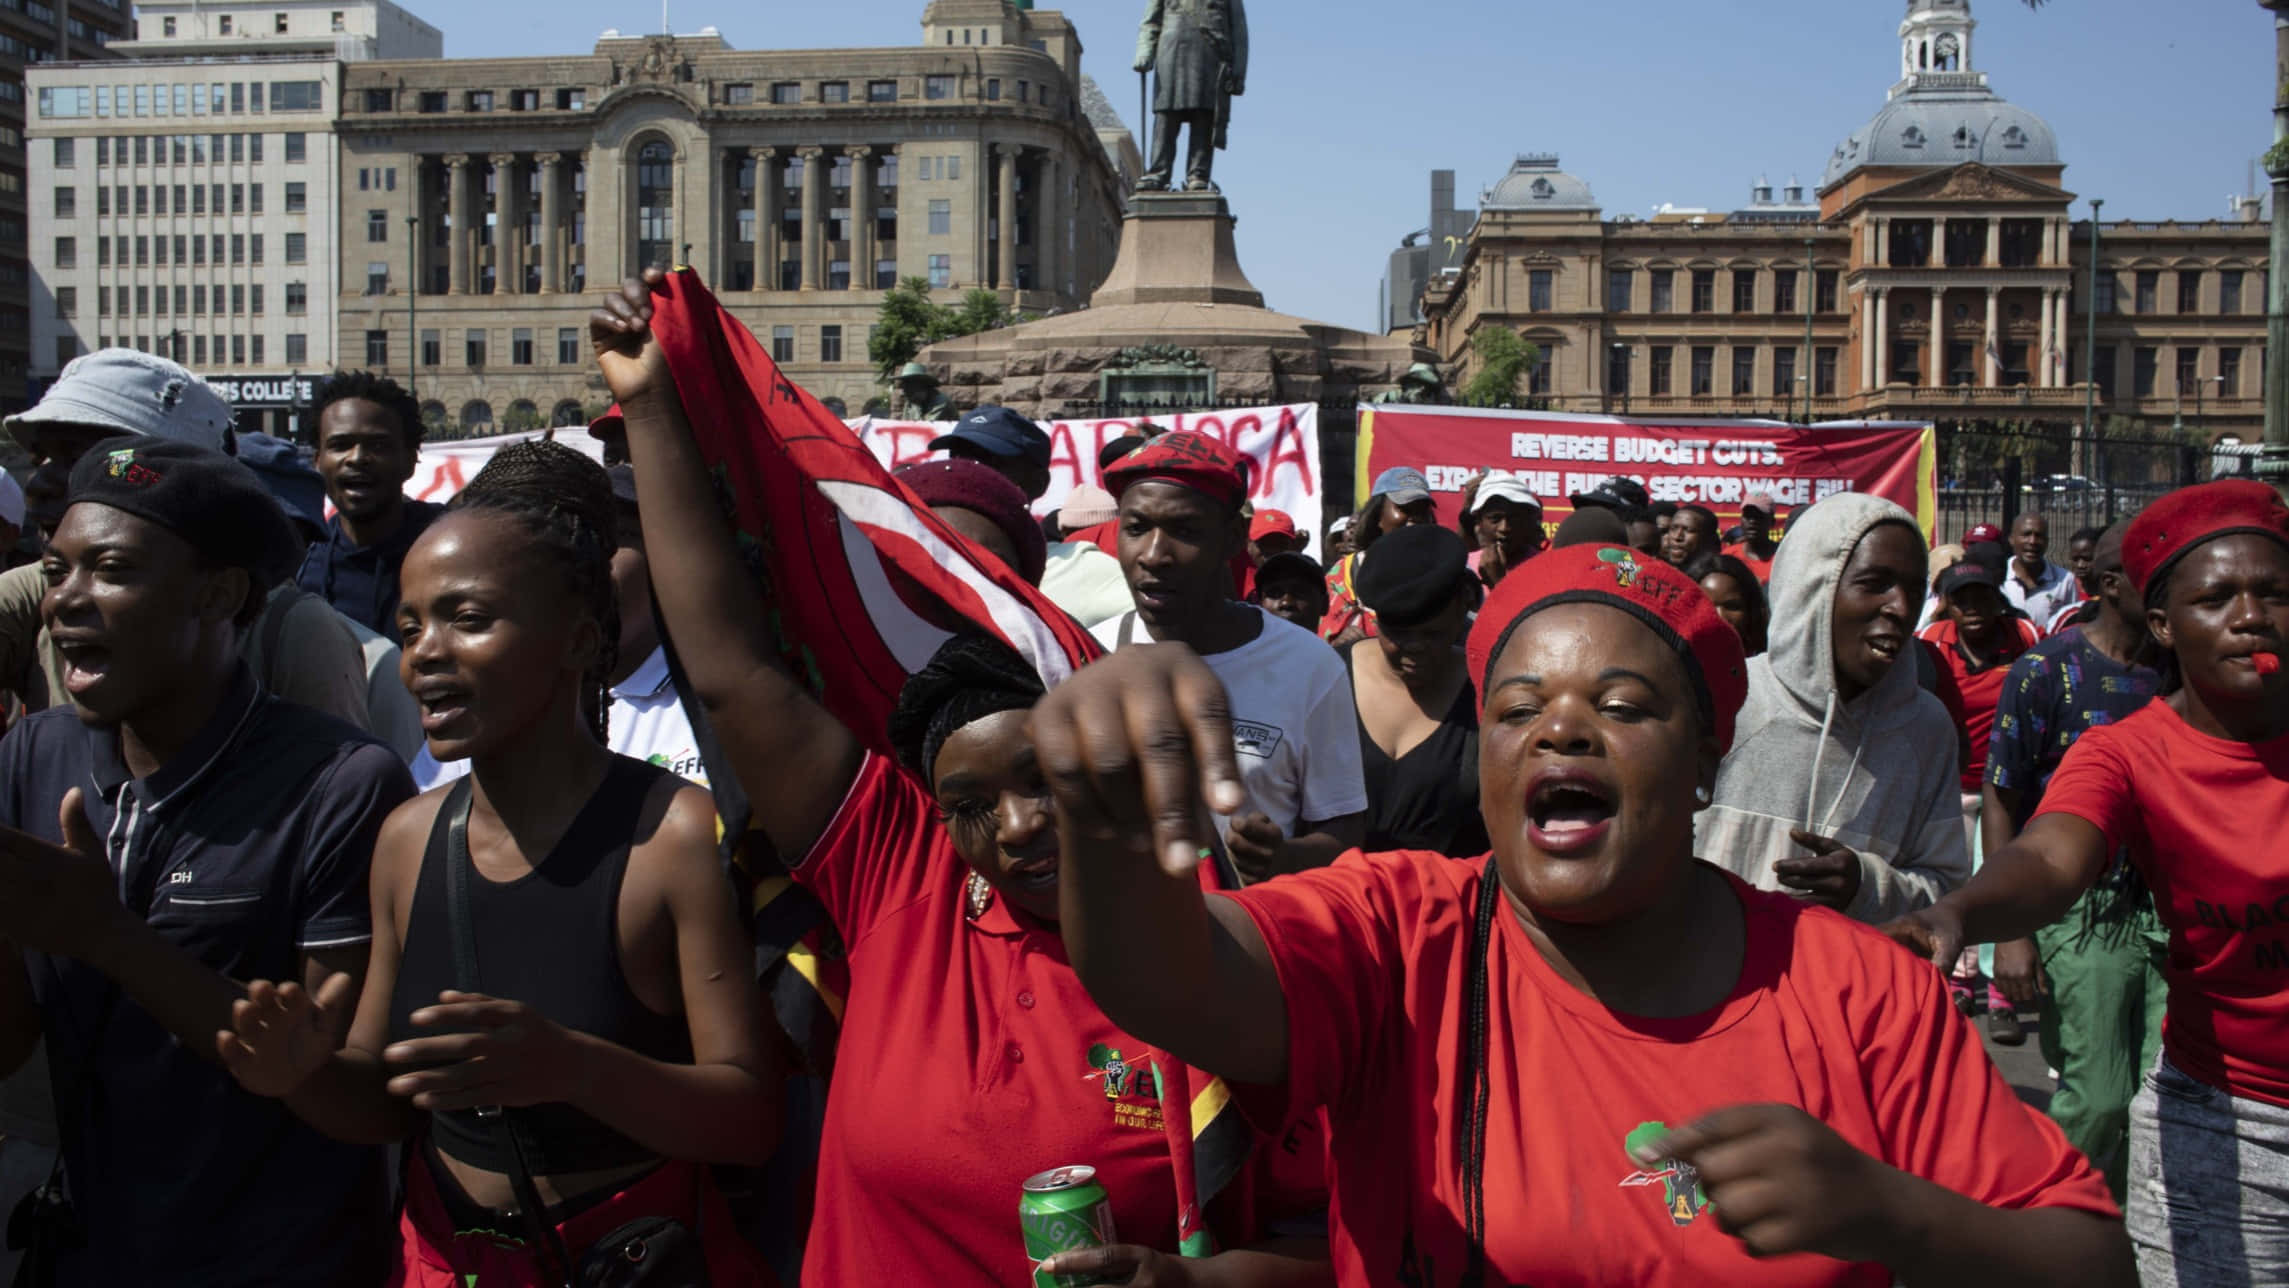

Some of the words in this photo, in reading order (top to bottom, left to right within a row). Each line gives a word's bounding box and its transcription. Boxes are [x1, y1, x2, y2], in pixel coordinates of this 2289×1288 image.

[1511, 432, 1609, 462] REVERSE
[1614, 437, 1710, 465] BUDGET
[1712, 440, 1784, 466] CUTS.
[1426, 465, 1512, 493] EXP
[1513, 469, 1559, 497] THE
[1649, 476, 1742, 504] SECTOR
[1742, 478, 1811, 506] WAGE
[1643, 575, 1683, 606] EFF
[170, 871, 192, 884] DH
